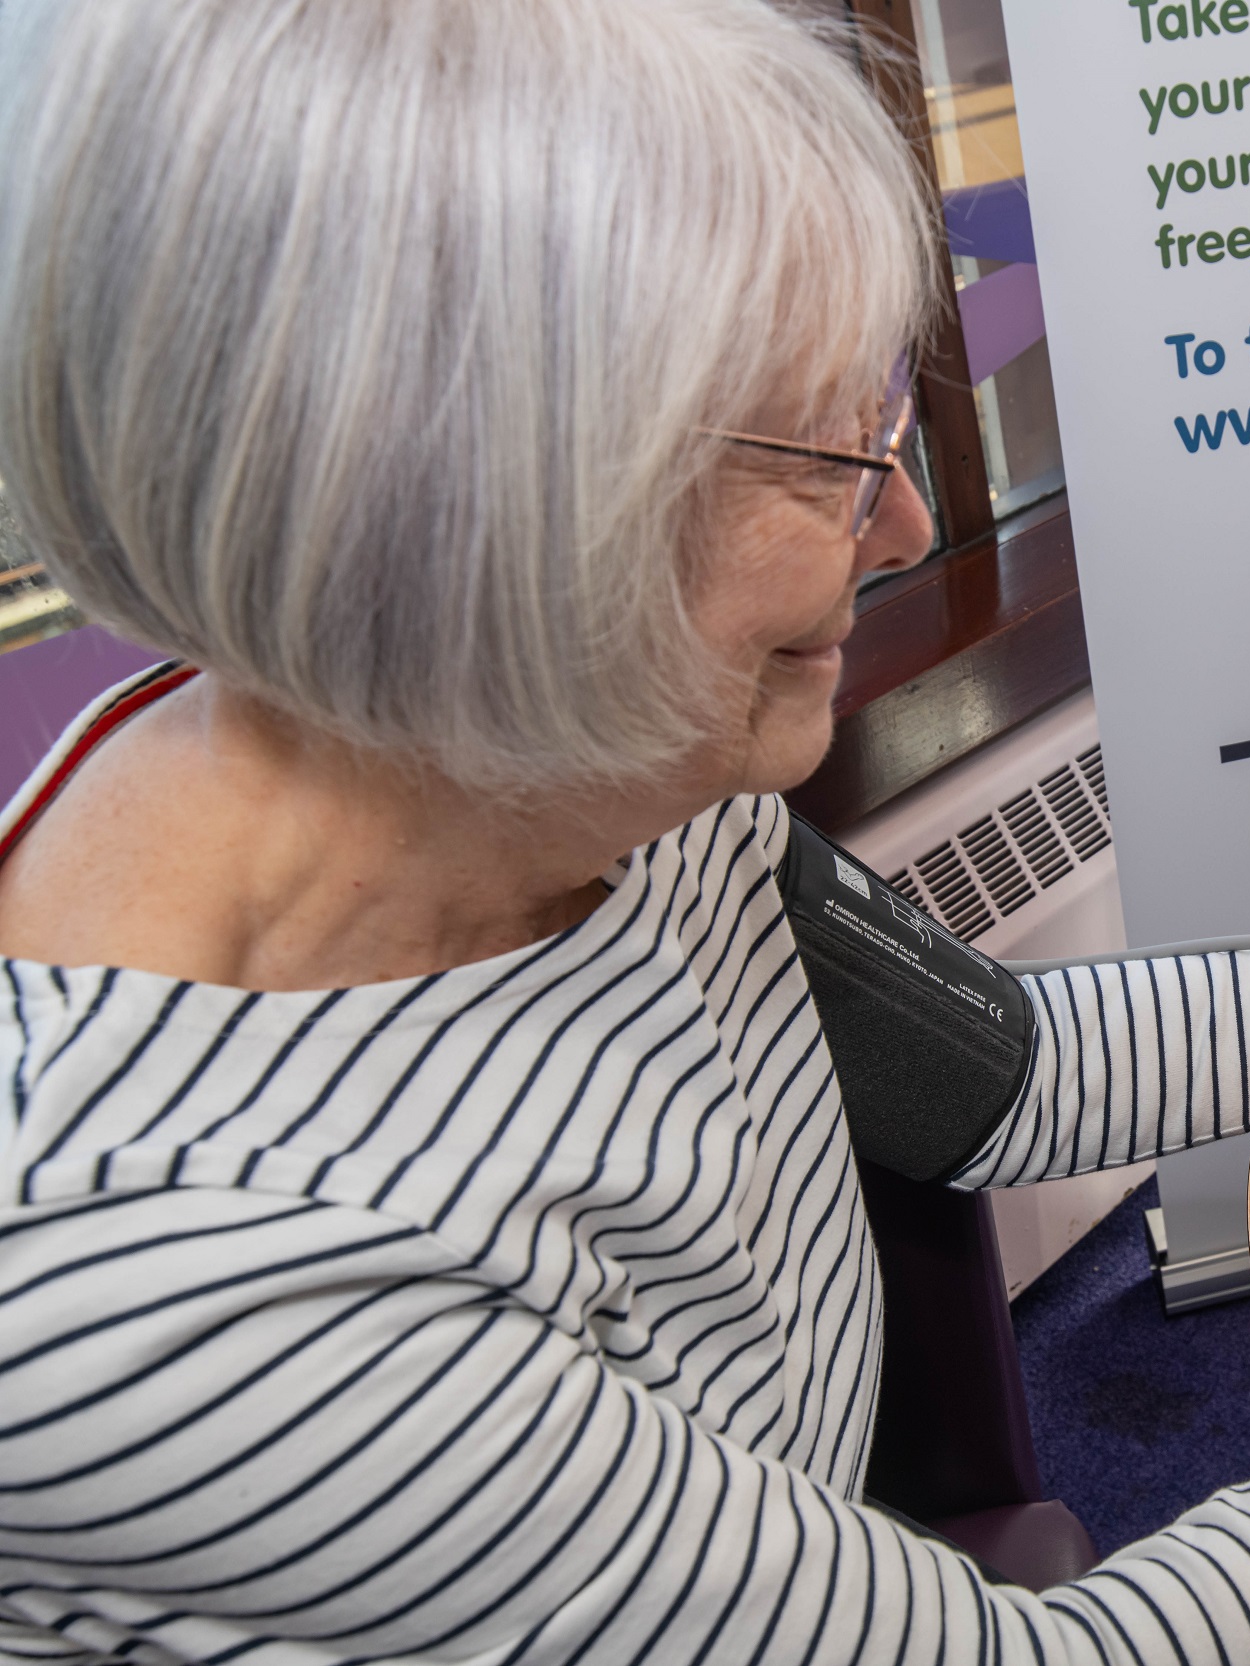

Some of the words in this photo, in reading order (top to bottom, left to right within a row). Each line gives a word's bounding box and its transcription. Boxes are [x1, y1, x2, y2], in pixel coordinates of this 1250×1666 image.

[1128, 0, 1249, 43] Take
[1164, 333, 1226, 378] To
[834, 904, 859, 923] OMRON
[859, 919, 898, 948] HEALTHCARE
[947, 983, 960, 996] MADE
[966, 996, 985, 1010] VIETNAM
[959, 983, 973, 996] LATEX
[974, 992, 986, 1002] FREE
